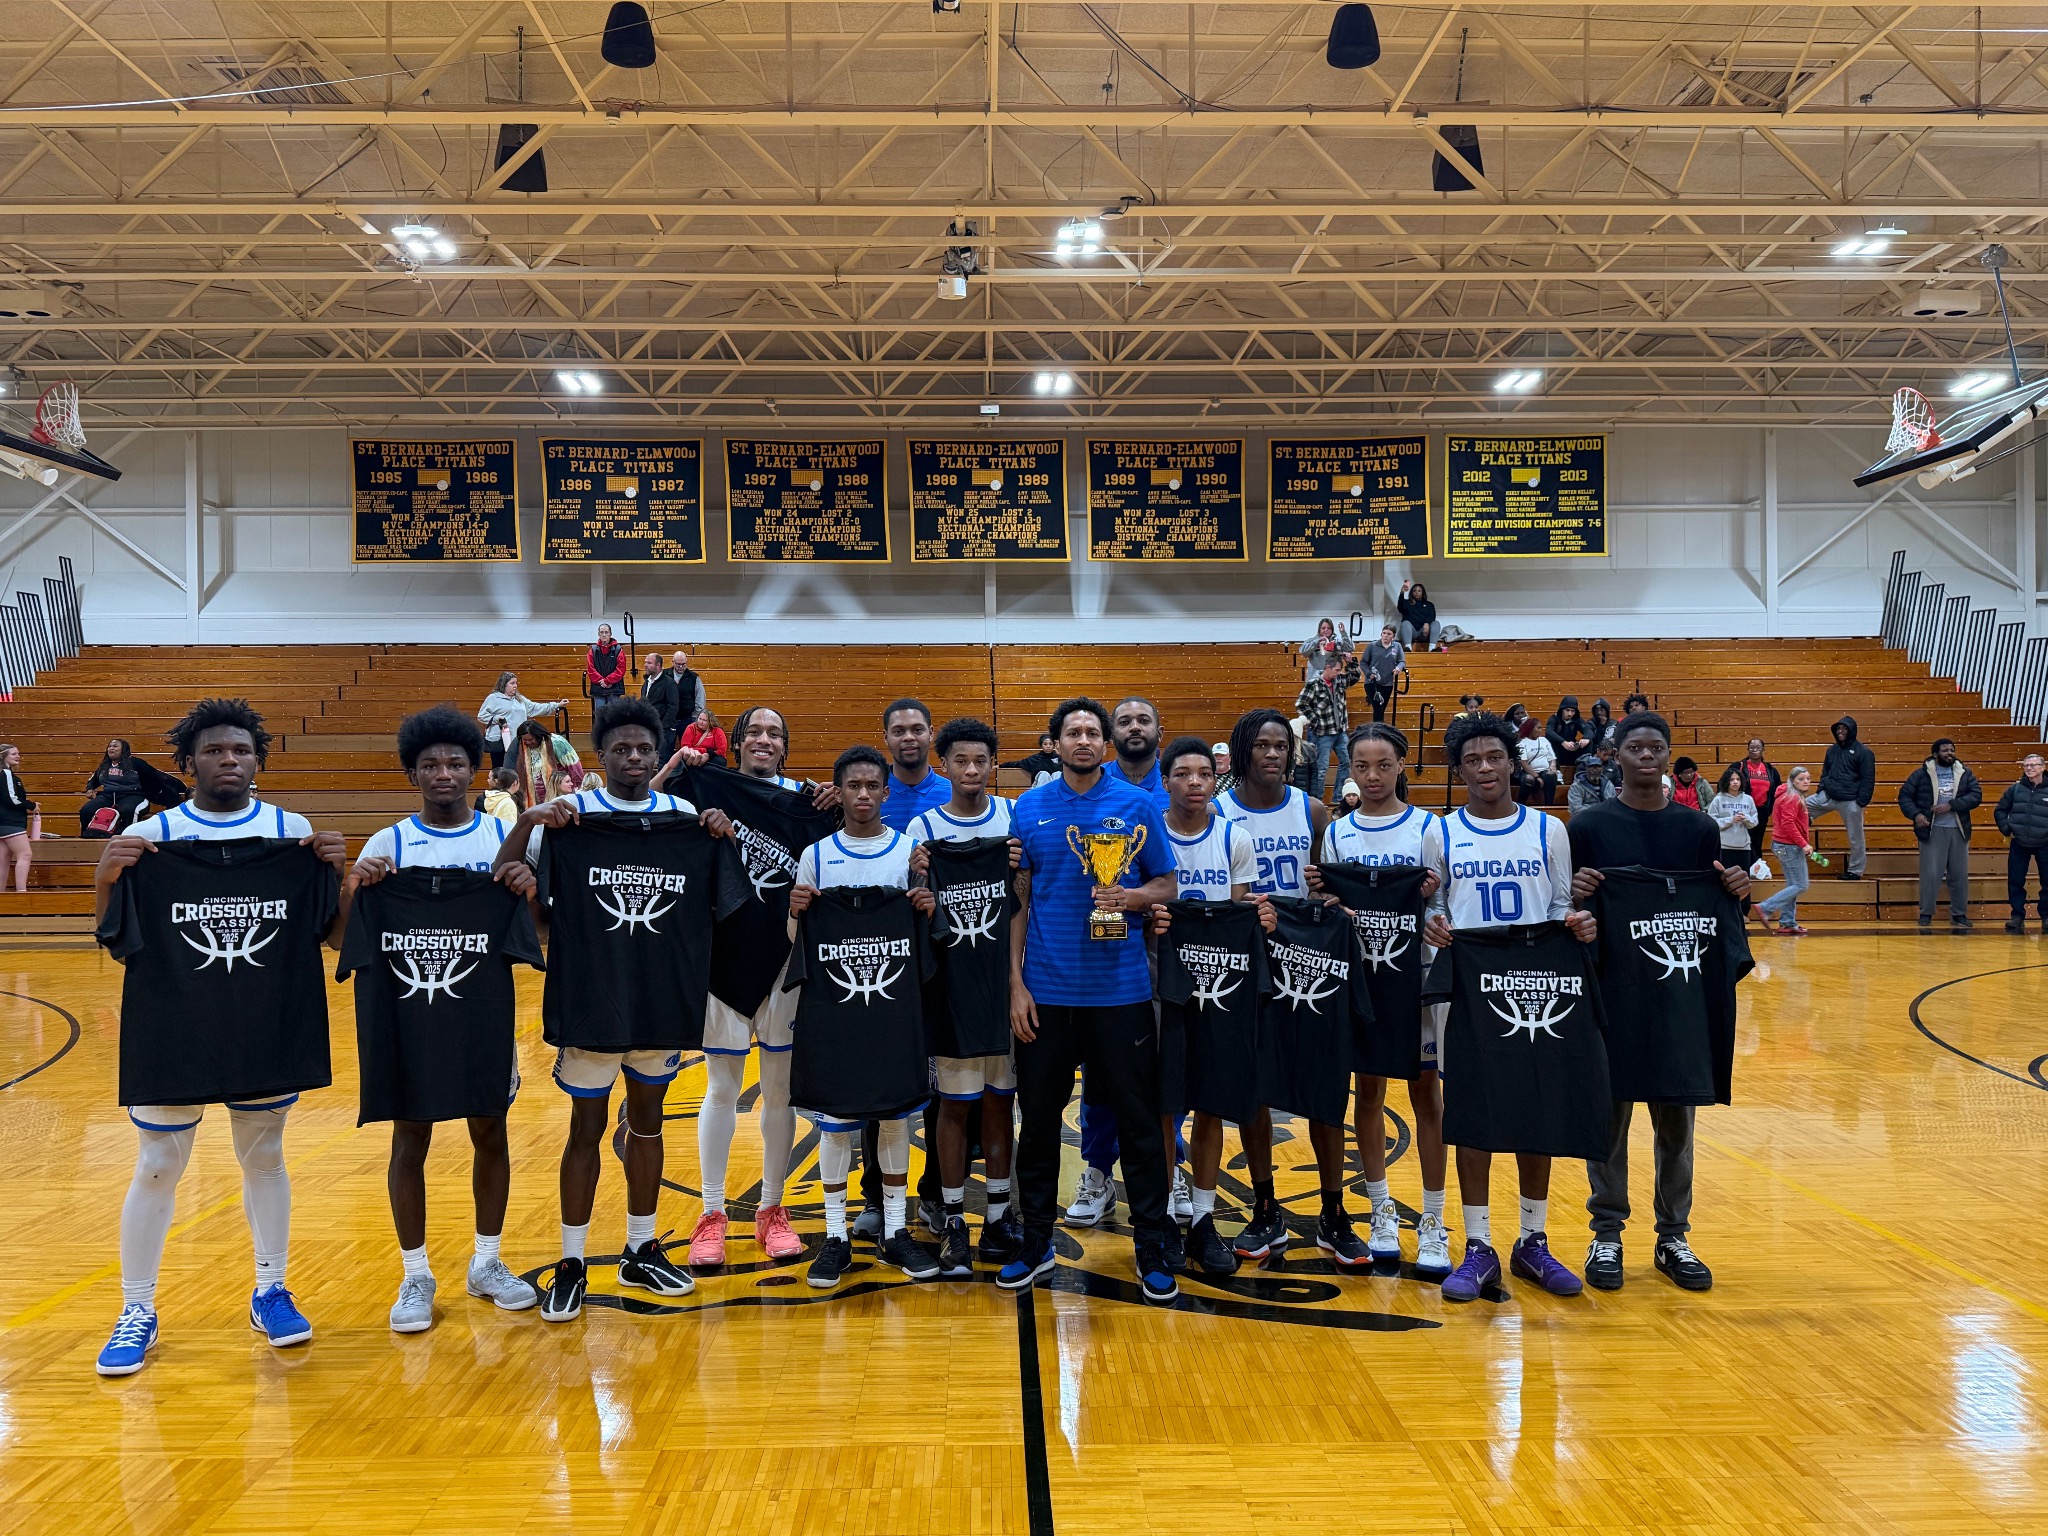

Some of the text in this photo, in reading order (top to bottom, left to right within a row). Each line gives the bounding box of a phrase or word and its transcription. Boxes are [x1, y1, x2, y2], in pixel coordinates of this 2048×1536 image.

[358, 443, 509, 456] ST. BERNARD-ELMWOOD
[732, 443, 880, 456] ST. BERNARD-ELMWOOD
[915, 443, 1058, 455] ST. BERNARD-ELMWOOD
[1094, 443, 1237, 455] ST. BERNARD-ELMWOOD
[1276, 443, 1421, 459] ST. BERNARD-ELMWOOD
[1451, 439, 1601, 452] ST. BERNARD-ELMWOOD
[549, 447, 696, 459] ST. BERNARD-ELMWOOD
[383, 457, 485, 468] PLACE TITANS
[756, 457, 857, 468] PLACE TITANS
[940, 457, 1036, 468] PLACE TITANS
[1117, 457, 1214, 468] PLACE TITANS
[1481, 453, 1571, 465] PLACE TITANS
[571, 461, 674, 473] PLACE TITANS
[1298, 459, 1399, 472] PLACE TITANS
[371, 472, 498, 483] 1985 1986
[745, 474, 868, 486] 1987 1988
[926, 475, 1048, 485] 1988 1989
[1105, 474, 1227, 485] 1989 1990
[1463, 470, 1587, 482] 2012 2013
[560, 480, 684, 491] 1986 1987
[1287, 476, 1409, 490] 1990 1991
[764, 509, 782, 517] WON
[1451, 519, 1601, 528] MVC GRAY DIVISION CHAMPIONS 7-6
[441, 529, 486, 537] CHAMPION
[1328, 528, 1389, 536] CO-CHAMPIONS
[809, 534, 860, 542] CHAMPIONS
[753, 828, 790, 854] CINCINNATI
[742, 842, 782, 872] CLASSIC
[616, 864, 663, 874] CINCINNATI
[1252, 855, 1299, 892] 20
[1453, 860, 1542, 879] COUGARS
[589, 867, 686, 894] CROSSOVER
[946, 880, 987, 890] CINCINNATI
[612, 885, 662, 896] CLASSIC
[939, 880, 1006, 906] ROSSOVER
[203, 896, 258, 904] CINCINNATI
[628, 898, 642, 908] 2025
[949, 898, 991, 911] CLASSIC
[1476, 882, 1523, 921] 10
[172, 900, 287, 923] CROSSOVER
[200, 918, 261, 929] CLASSIC
[963, 913, 977, 923] 2025
[1629, 916, 1717, 940] CROSSOVER
[222, 933, 239, 943] 2025
[382, 931, 488, 953] CROSSOVER
[841, 936, 887, 945] CINCINNATI
[818, 938, 911, 962] CROSSOVER
[1183, 944, 1228, 953] CINCINNATI
[1289, 943, 1331, 958] CINCINNATI
[1368, 940, 1382, 950] 2025
[404, 950, 463, 960] CLASSIC
[840, 956, 890, 966] CLASSIC
[424, 965, 440, 974] 2025
[859, 970, 873, 979] 2025
[1281, 961, 1328, 979] CLASSIC
[1507, 969, 1556, 978] CINCINNATI
[1196, 976, 1210, 988] 2025
[1480, 974, 1582, 996] CROSSOVER
[1504, 991, 1559, 1000] CLASSIC
[1524, 1005, 1540, 1014] 2025
